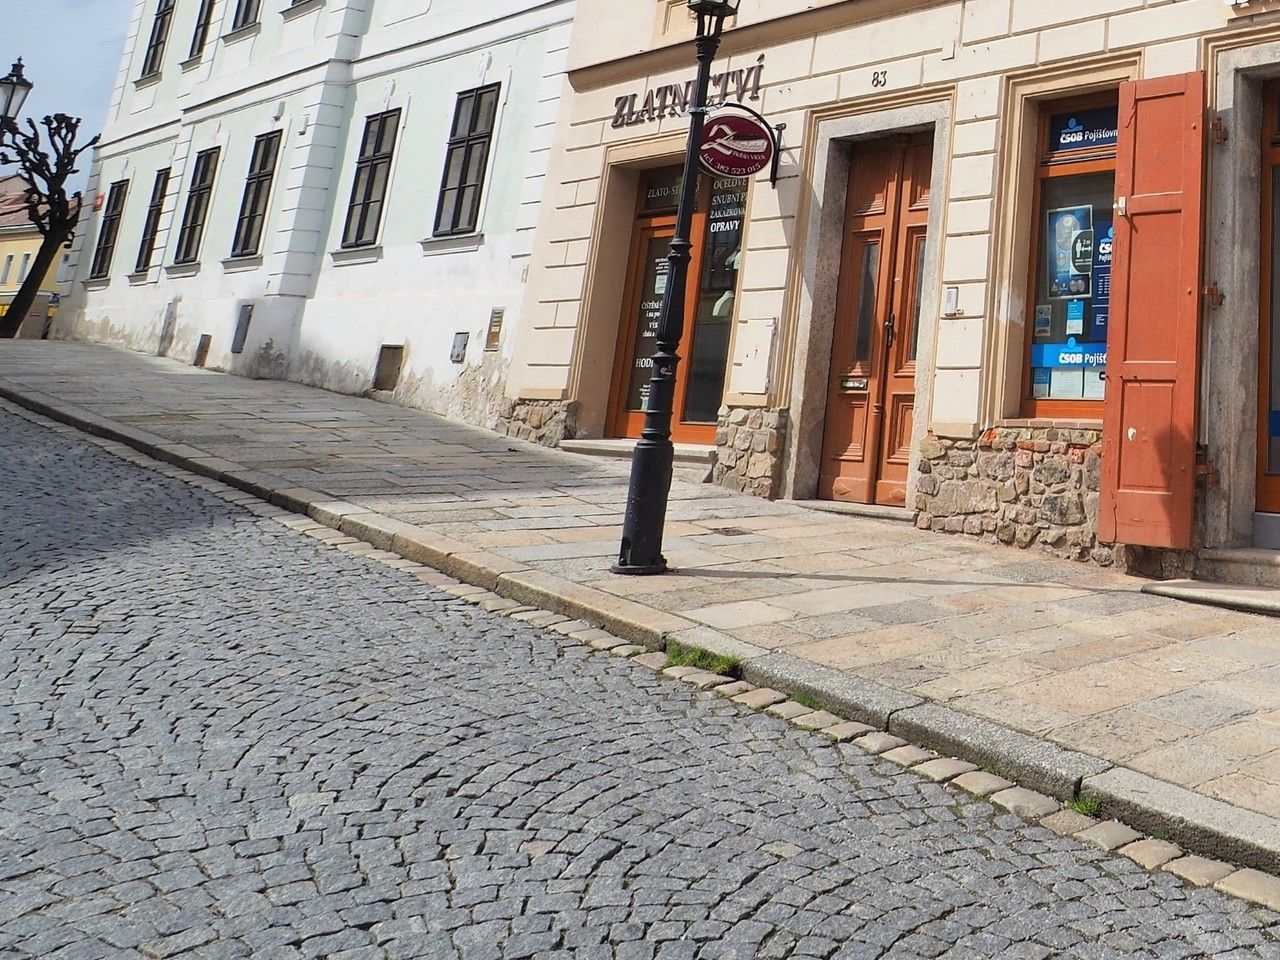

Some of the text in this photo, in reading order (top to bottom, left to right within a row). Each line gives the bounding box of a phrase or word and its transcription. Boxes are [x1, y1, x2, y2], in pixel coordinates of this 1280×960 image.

[872, 70, 887, 87] 83
[611, 53, 765, 129] ZLATNITVÍ
[1060, 132, 1083, 143] ČSOB
[714, 162, 729, 173] 382
[710, 220, 740, 233] OPRAVY
[1099, 242, 1112, 254] ČS
[1059, 353, 1083, 364] ČSOB
